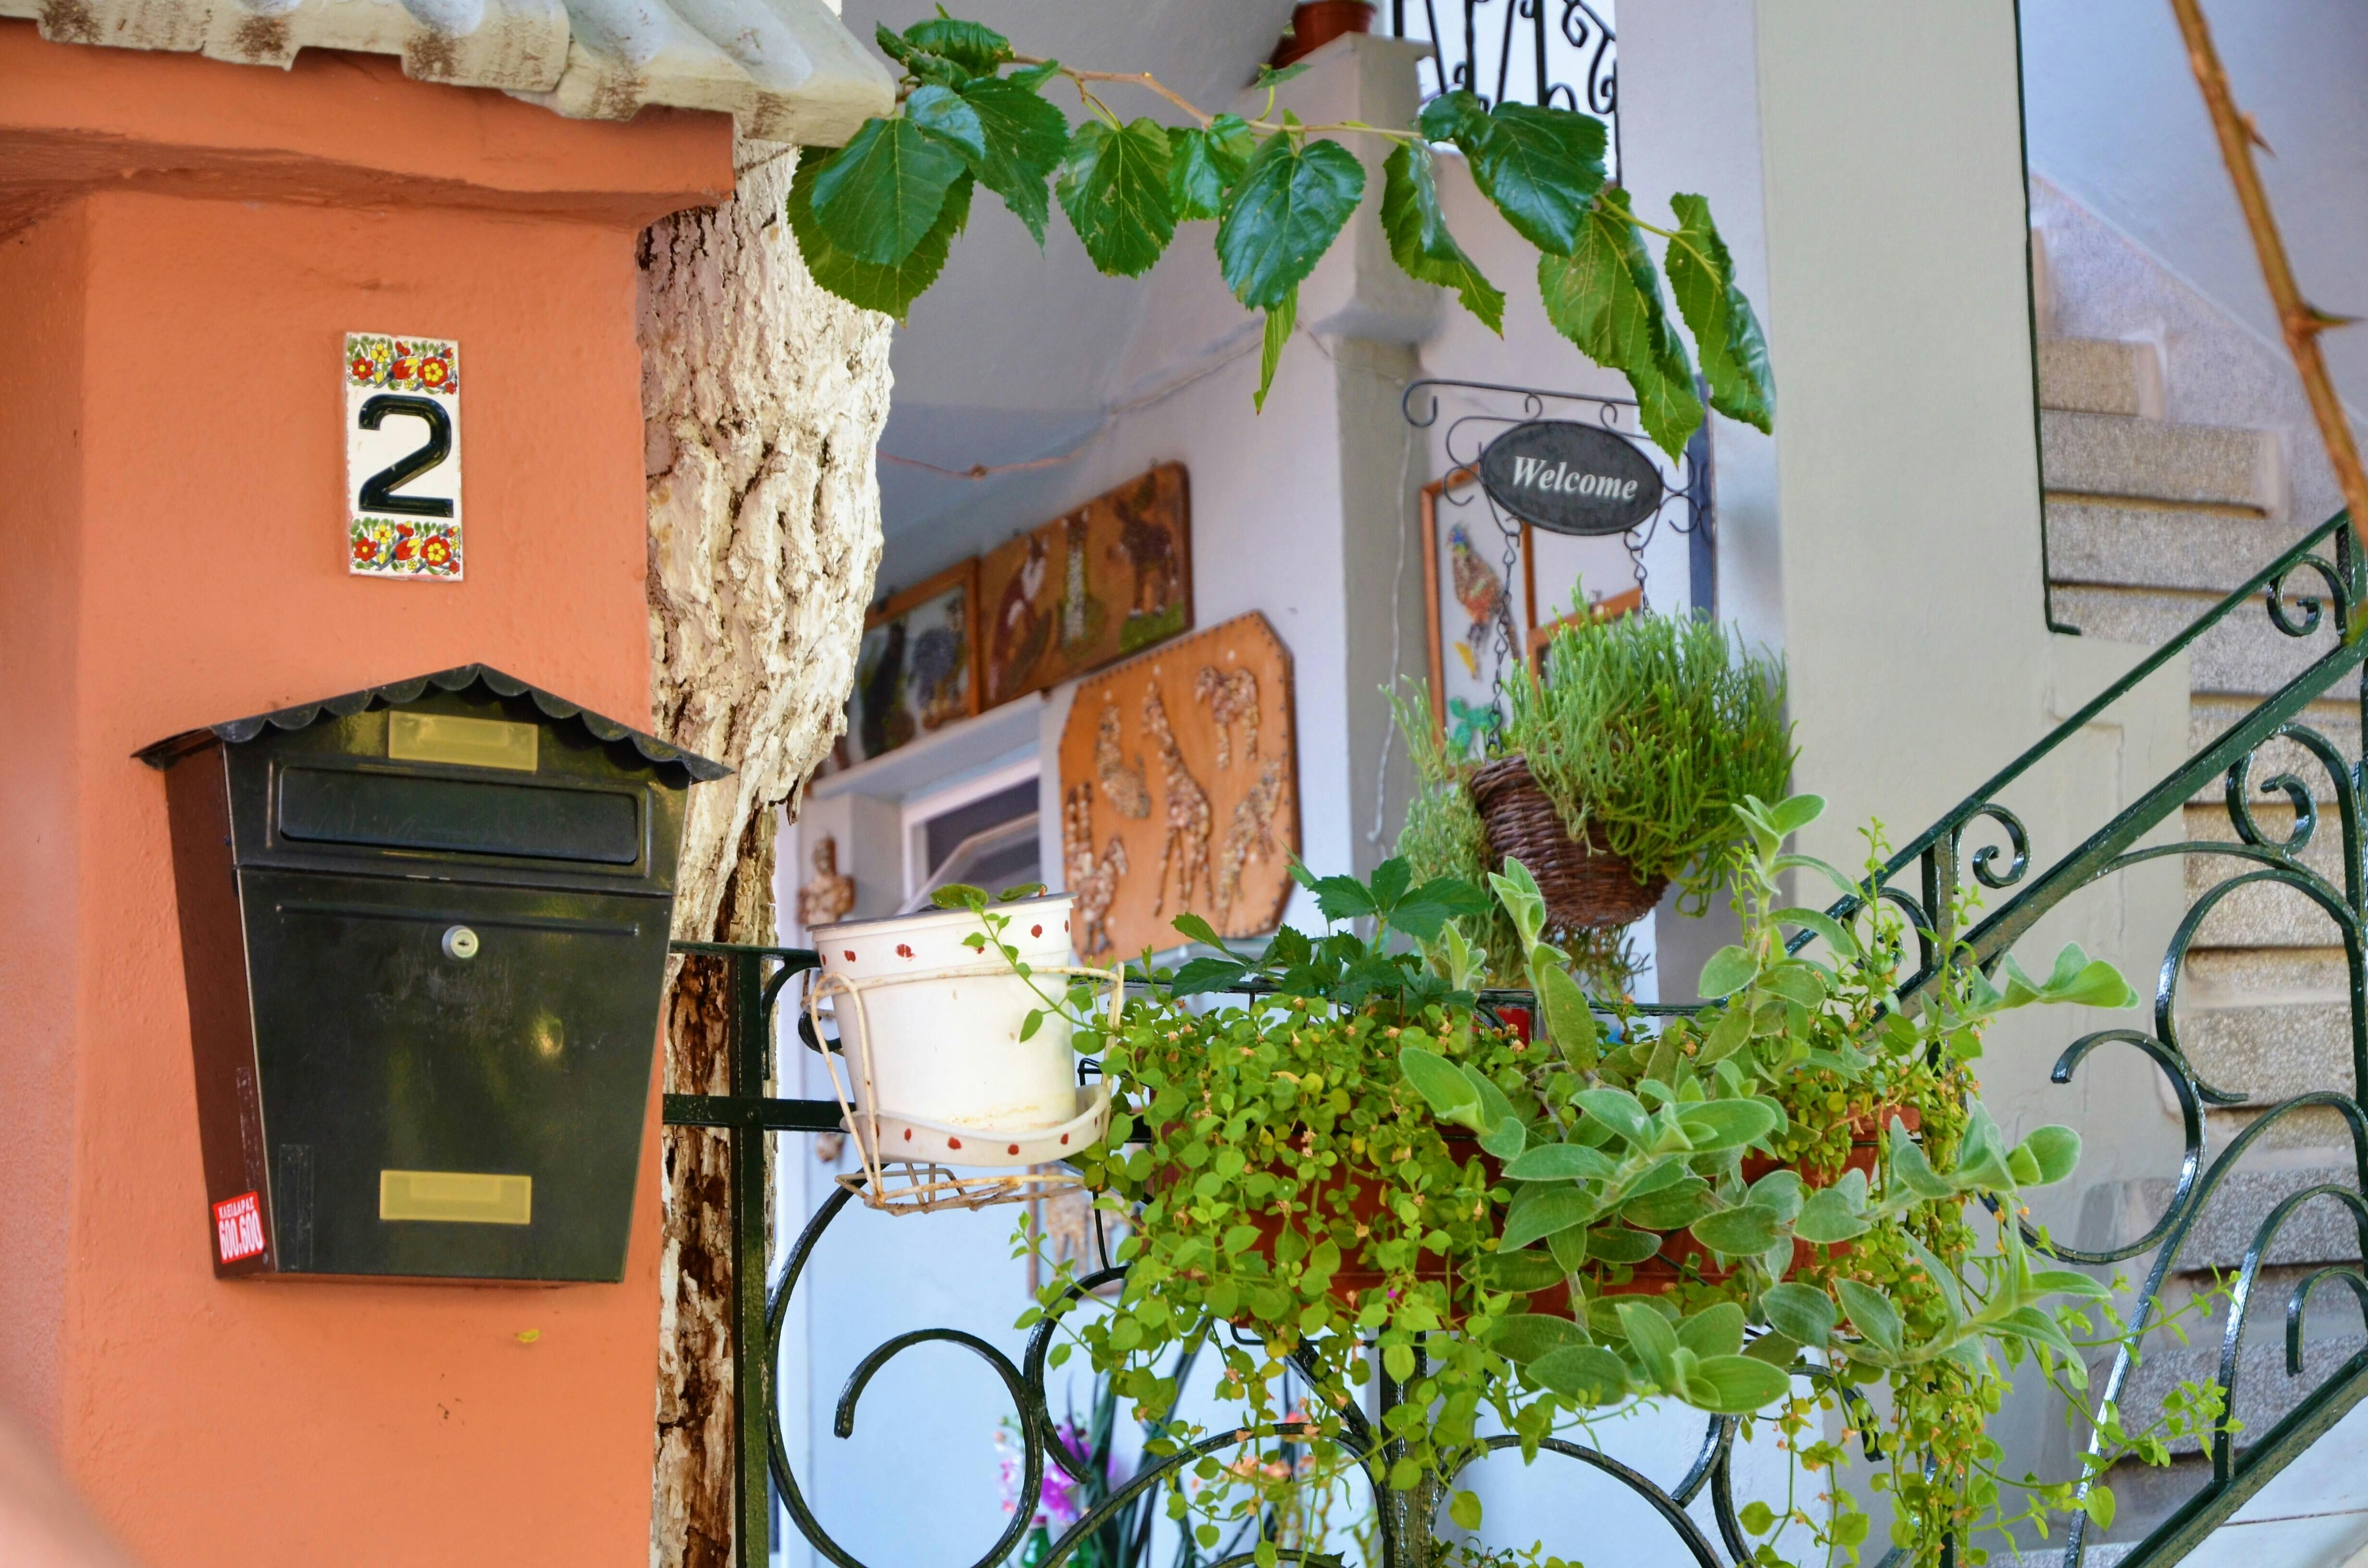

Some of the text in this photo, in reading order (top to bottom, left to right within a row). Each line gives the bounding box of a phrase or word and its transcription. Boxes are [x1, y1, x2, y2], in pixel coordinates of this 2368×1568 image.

[359, 394, 454, 518] 2
[1513, 456, 1638, 500] Welcome
[219, 1210, 263, 1260] 600.600
